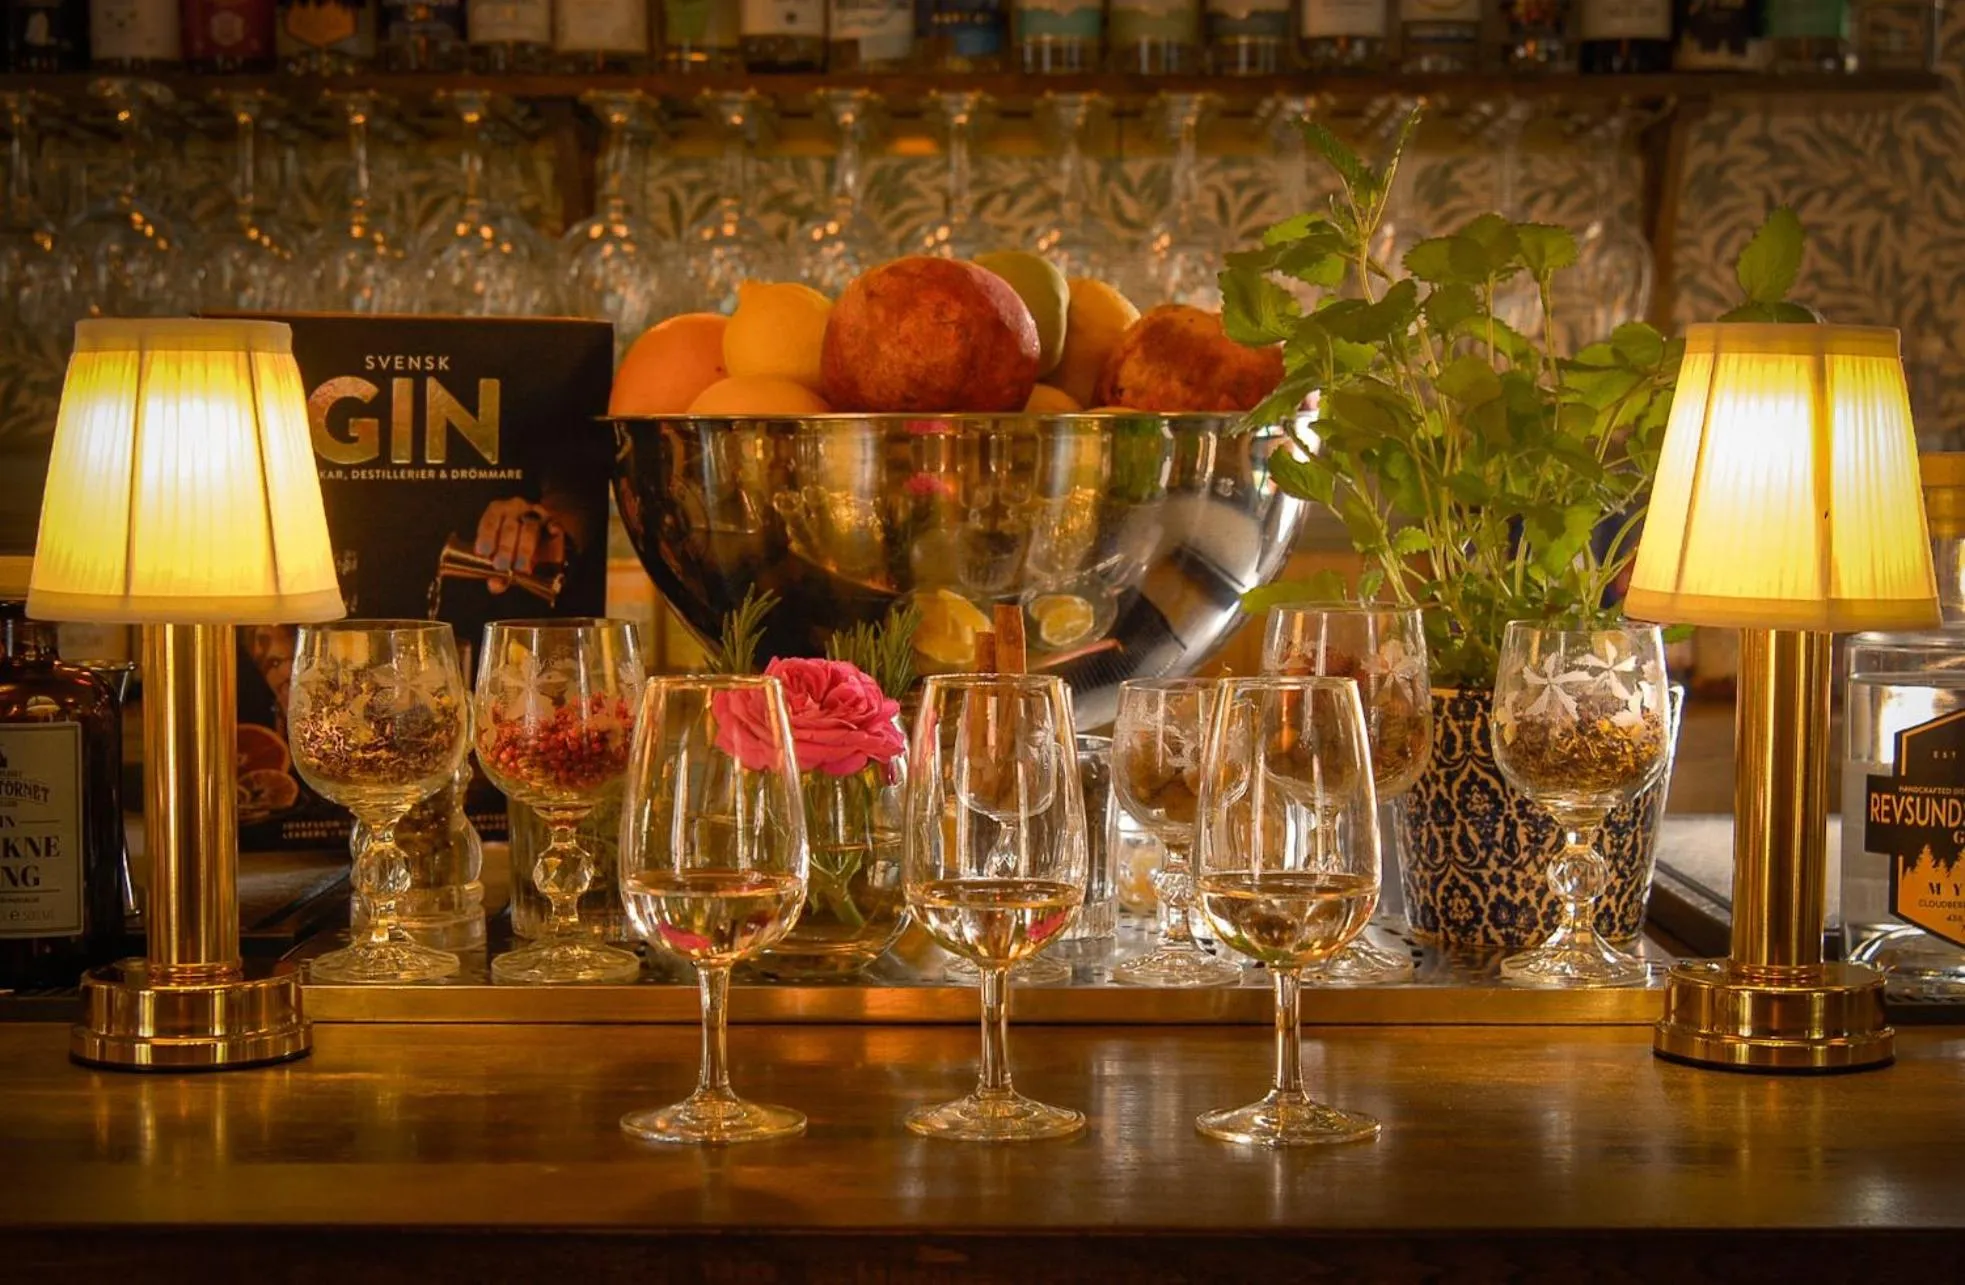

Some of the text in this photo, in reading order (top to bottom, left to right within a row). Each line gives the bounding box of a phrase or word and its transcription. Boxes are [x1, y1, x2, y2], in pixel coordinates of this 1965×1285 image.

[365, 355, 450, 371] SVENSK
[309, 376, 501, 465] GIN
[351, 469, 435, 481] DESTILLERIER
[440, 469, 448, 480] &
[451, 467, 523, 480] DRÖMMARE
